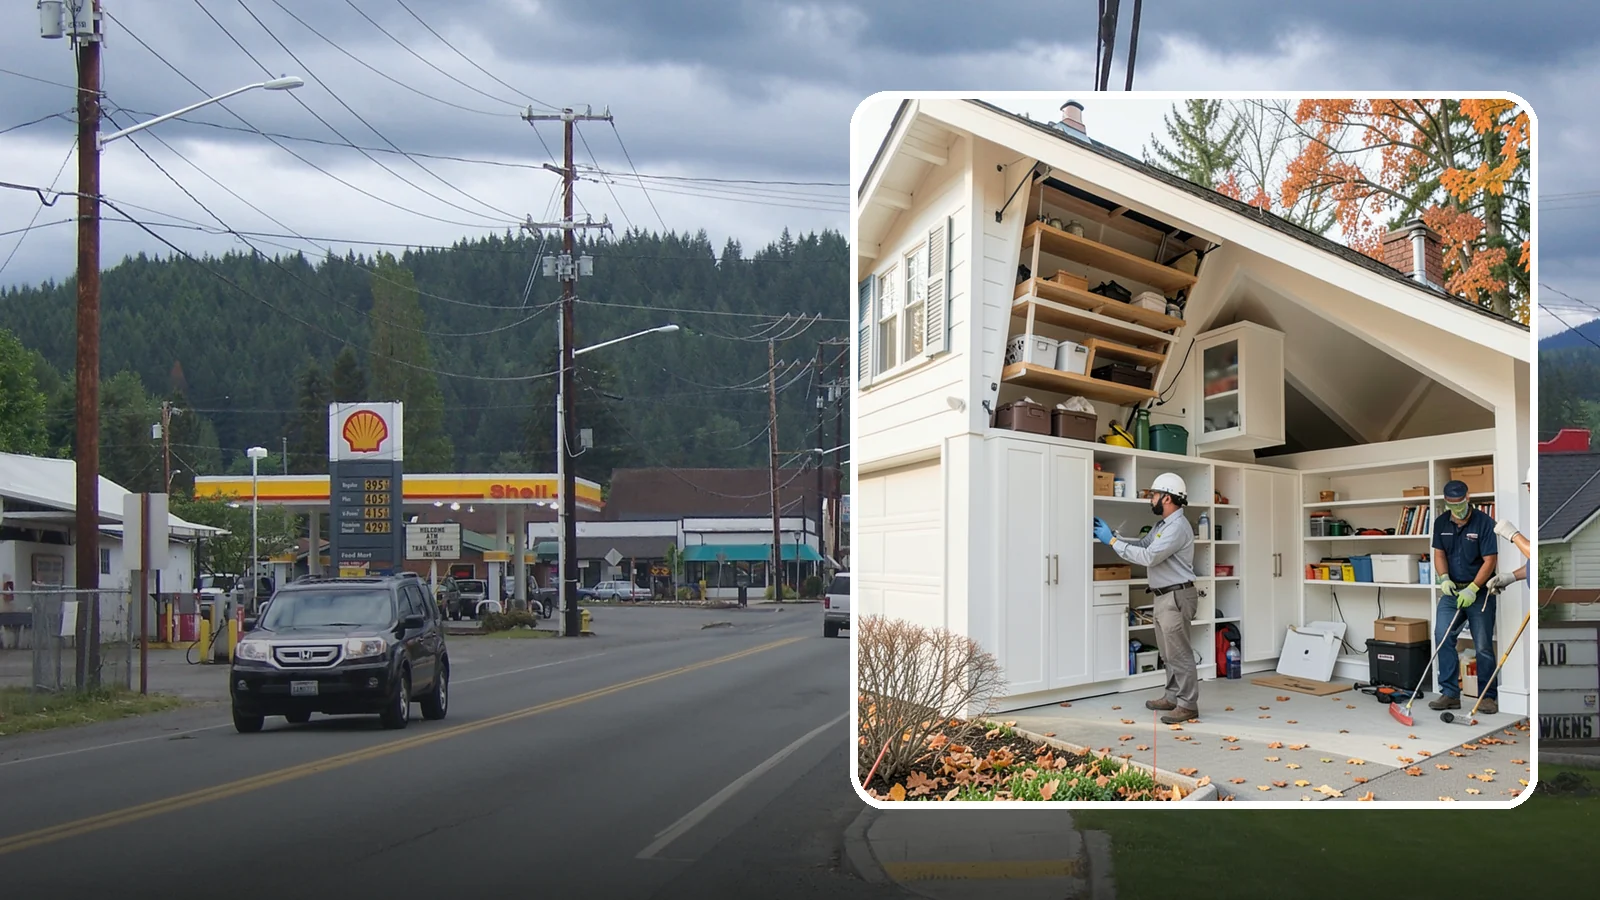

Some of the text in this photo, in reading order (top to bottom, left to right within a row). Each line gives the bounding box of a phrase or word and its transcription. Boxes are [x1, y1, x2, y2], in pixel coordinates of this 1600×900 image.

[365, 480, 383, 490] 395
[489, 484, 547, 499] Shell
[365, 494, 383, 504] 405
[365, 508, 383, 518] 415
[365, 522, 383, 533] 429
